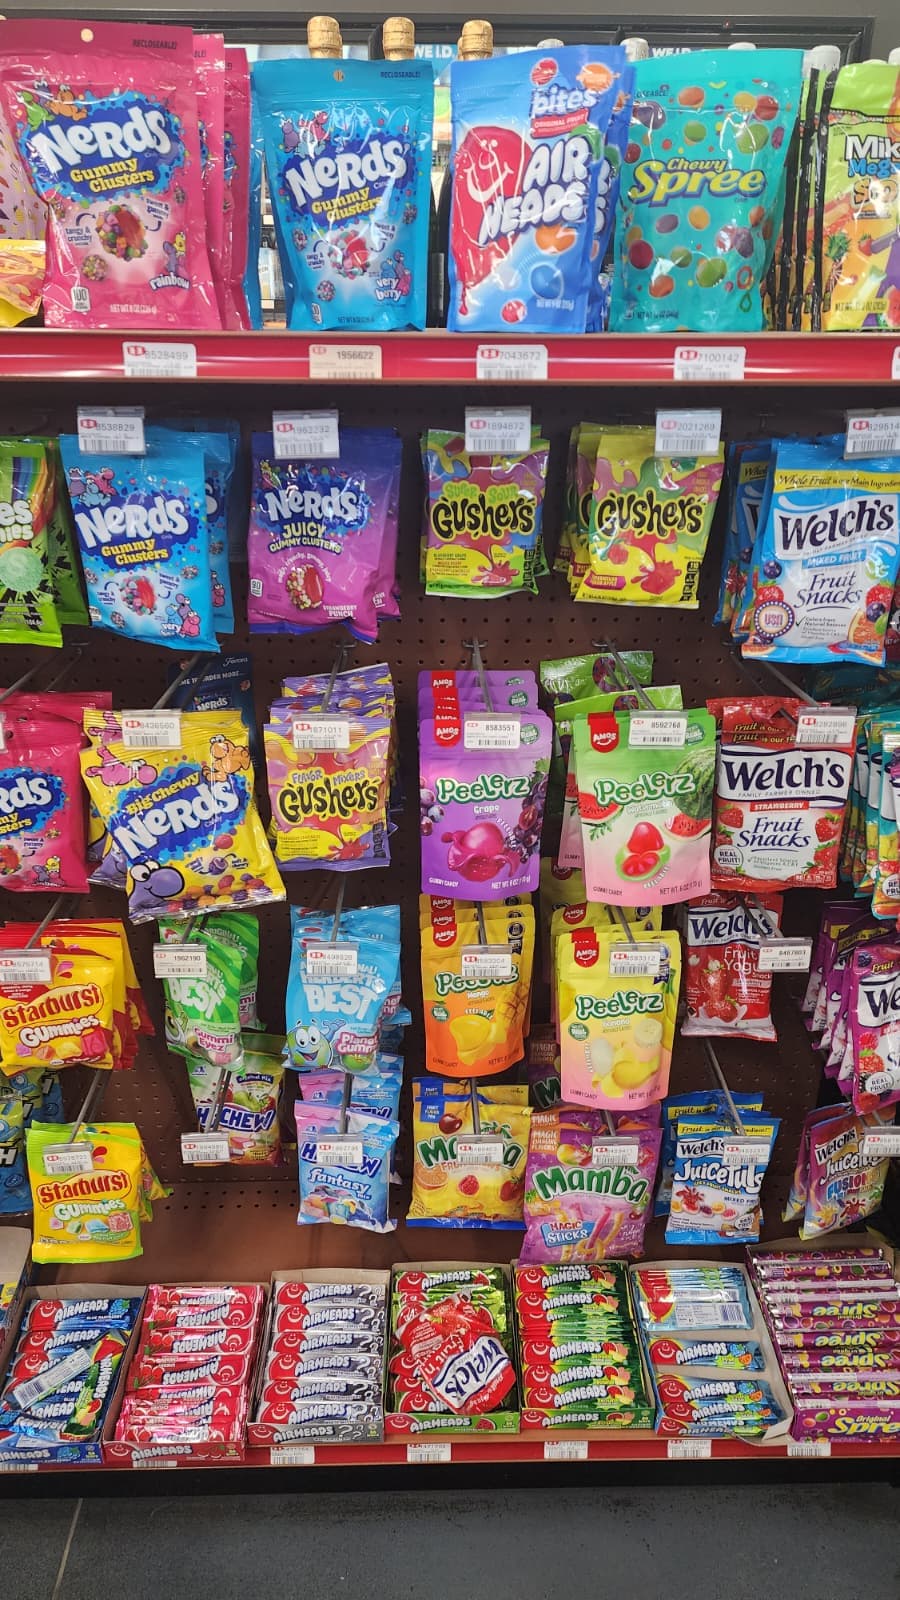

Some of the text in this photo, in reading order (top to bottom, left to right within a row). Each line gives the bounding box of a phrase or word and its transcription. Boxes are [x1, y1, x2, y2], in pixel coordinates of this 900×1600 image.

[844, 135, 900, 161] Mik
[70, 158, 138, 182] Gummy
[523, 135, 591, 192] AIR
[666, 157, 727, 174] Chewy
[89, 169, 154, 192] Clusters
[629, 158, 768, 206] Spree
[150, 273, 191, 291] rainbow
[282, 522, 327, 538] JUICY
[779, 499, 895, 551] Welch's
[101, 538, 156, 558] Gummy
[115, 548, 170, 566] Clusters
[809, 570, 858, 591] Fruit
[794, 588, 863, 609] Snacks
[722, 756, 845, 791] Welch's
[0, 818, 32, 836] sters
[752, 815, 805, 834] Fruit
[736, 829, 812, 848] Snacks
[724, 957, 761, 975] Yogu
[3, 986, 101, 1028] Starburst
[303, 984, 378, 1020] BEST
[20, 1016, 100, 1047] Gummies
[38, 1171, 129, 1206] Starburst
[533, 1166, 649, 1203] Mamba
[55, 1200, 126, 1221] Gummies
[827, 1417, 900, 1436] Spre
